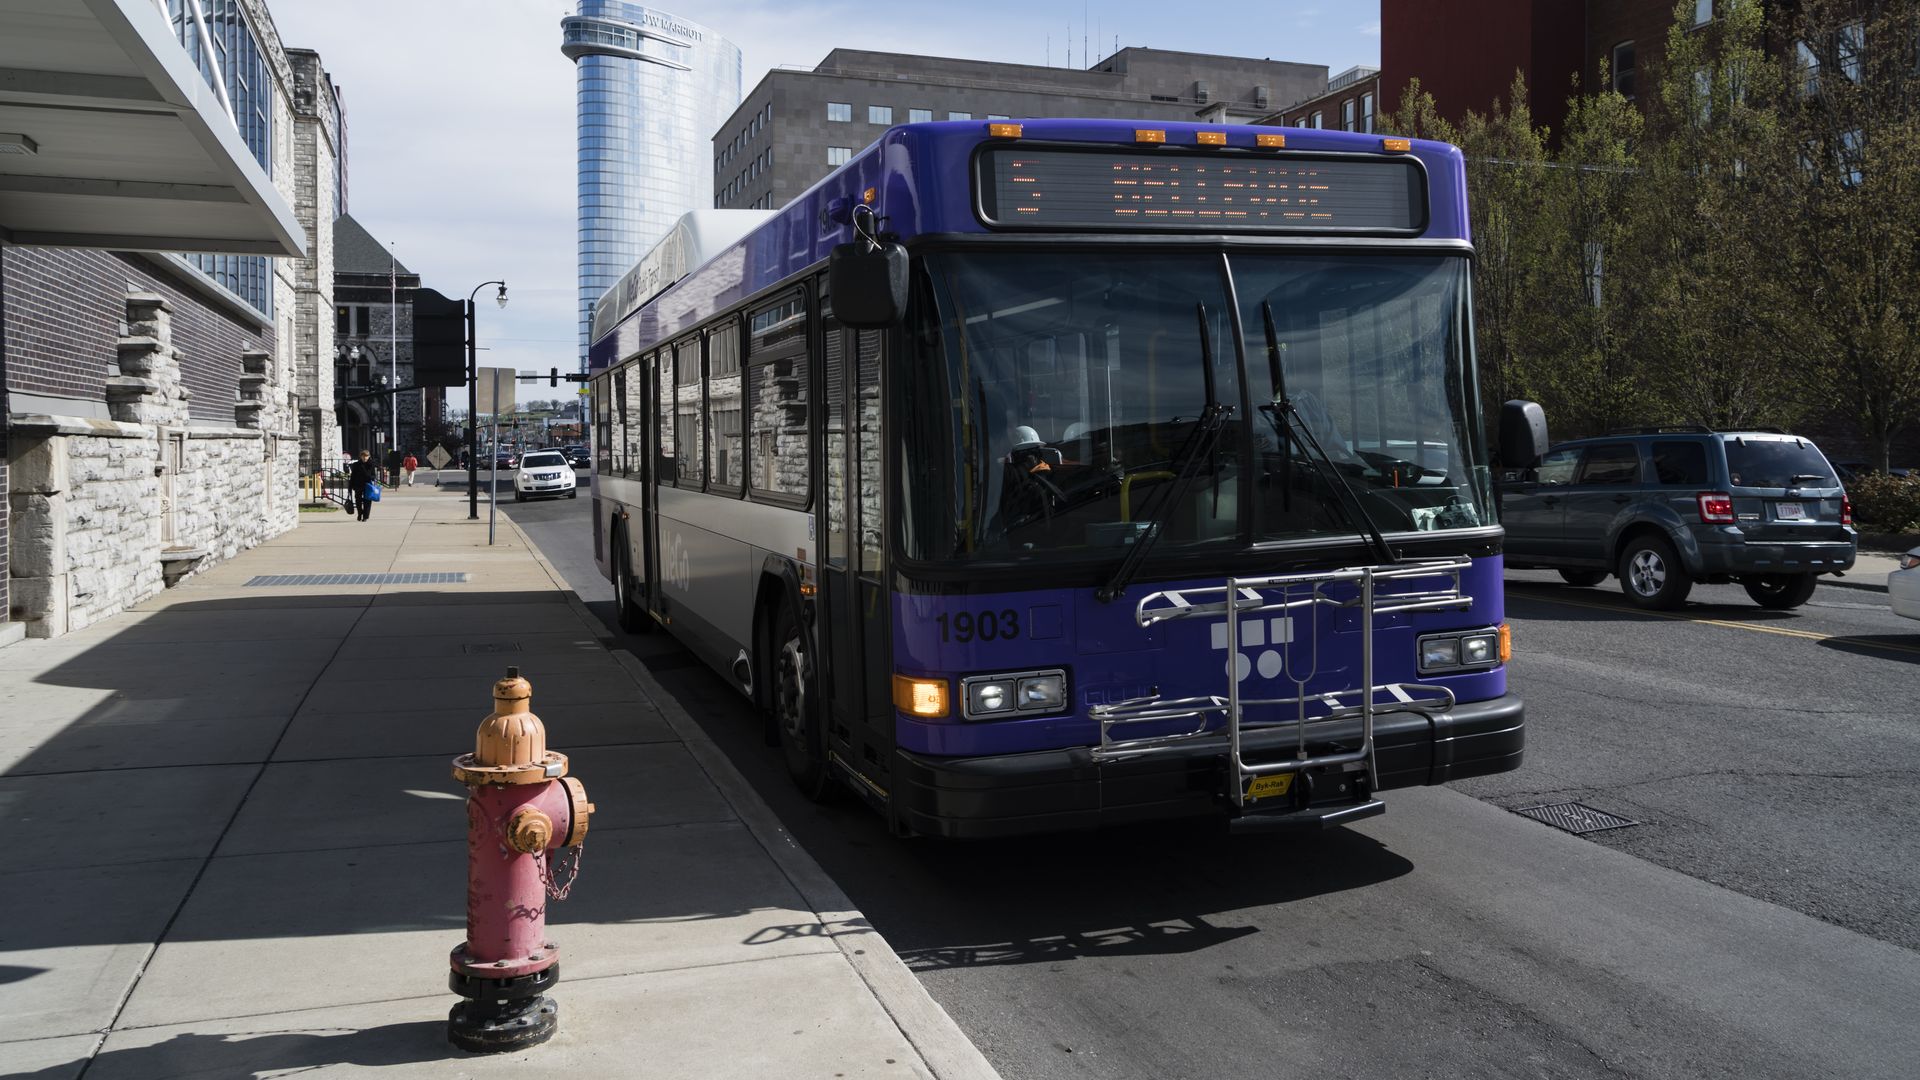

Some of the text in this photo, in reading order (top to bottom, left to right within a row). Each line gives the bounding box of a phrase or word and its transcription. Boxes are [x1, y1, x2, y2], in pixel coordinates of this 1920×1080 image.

[642, 14, 703, 42] JW MARRIOTT
[936, 608, 1020, 643] 1903
[1255, 780, 1284, 791] Byk-Rak
